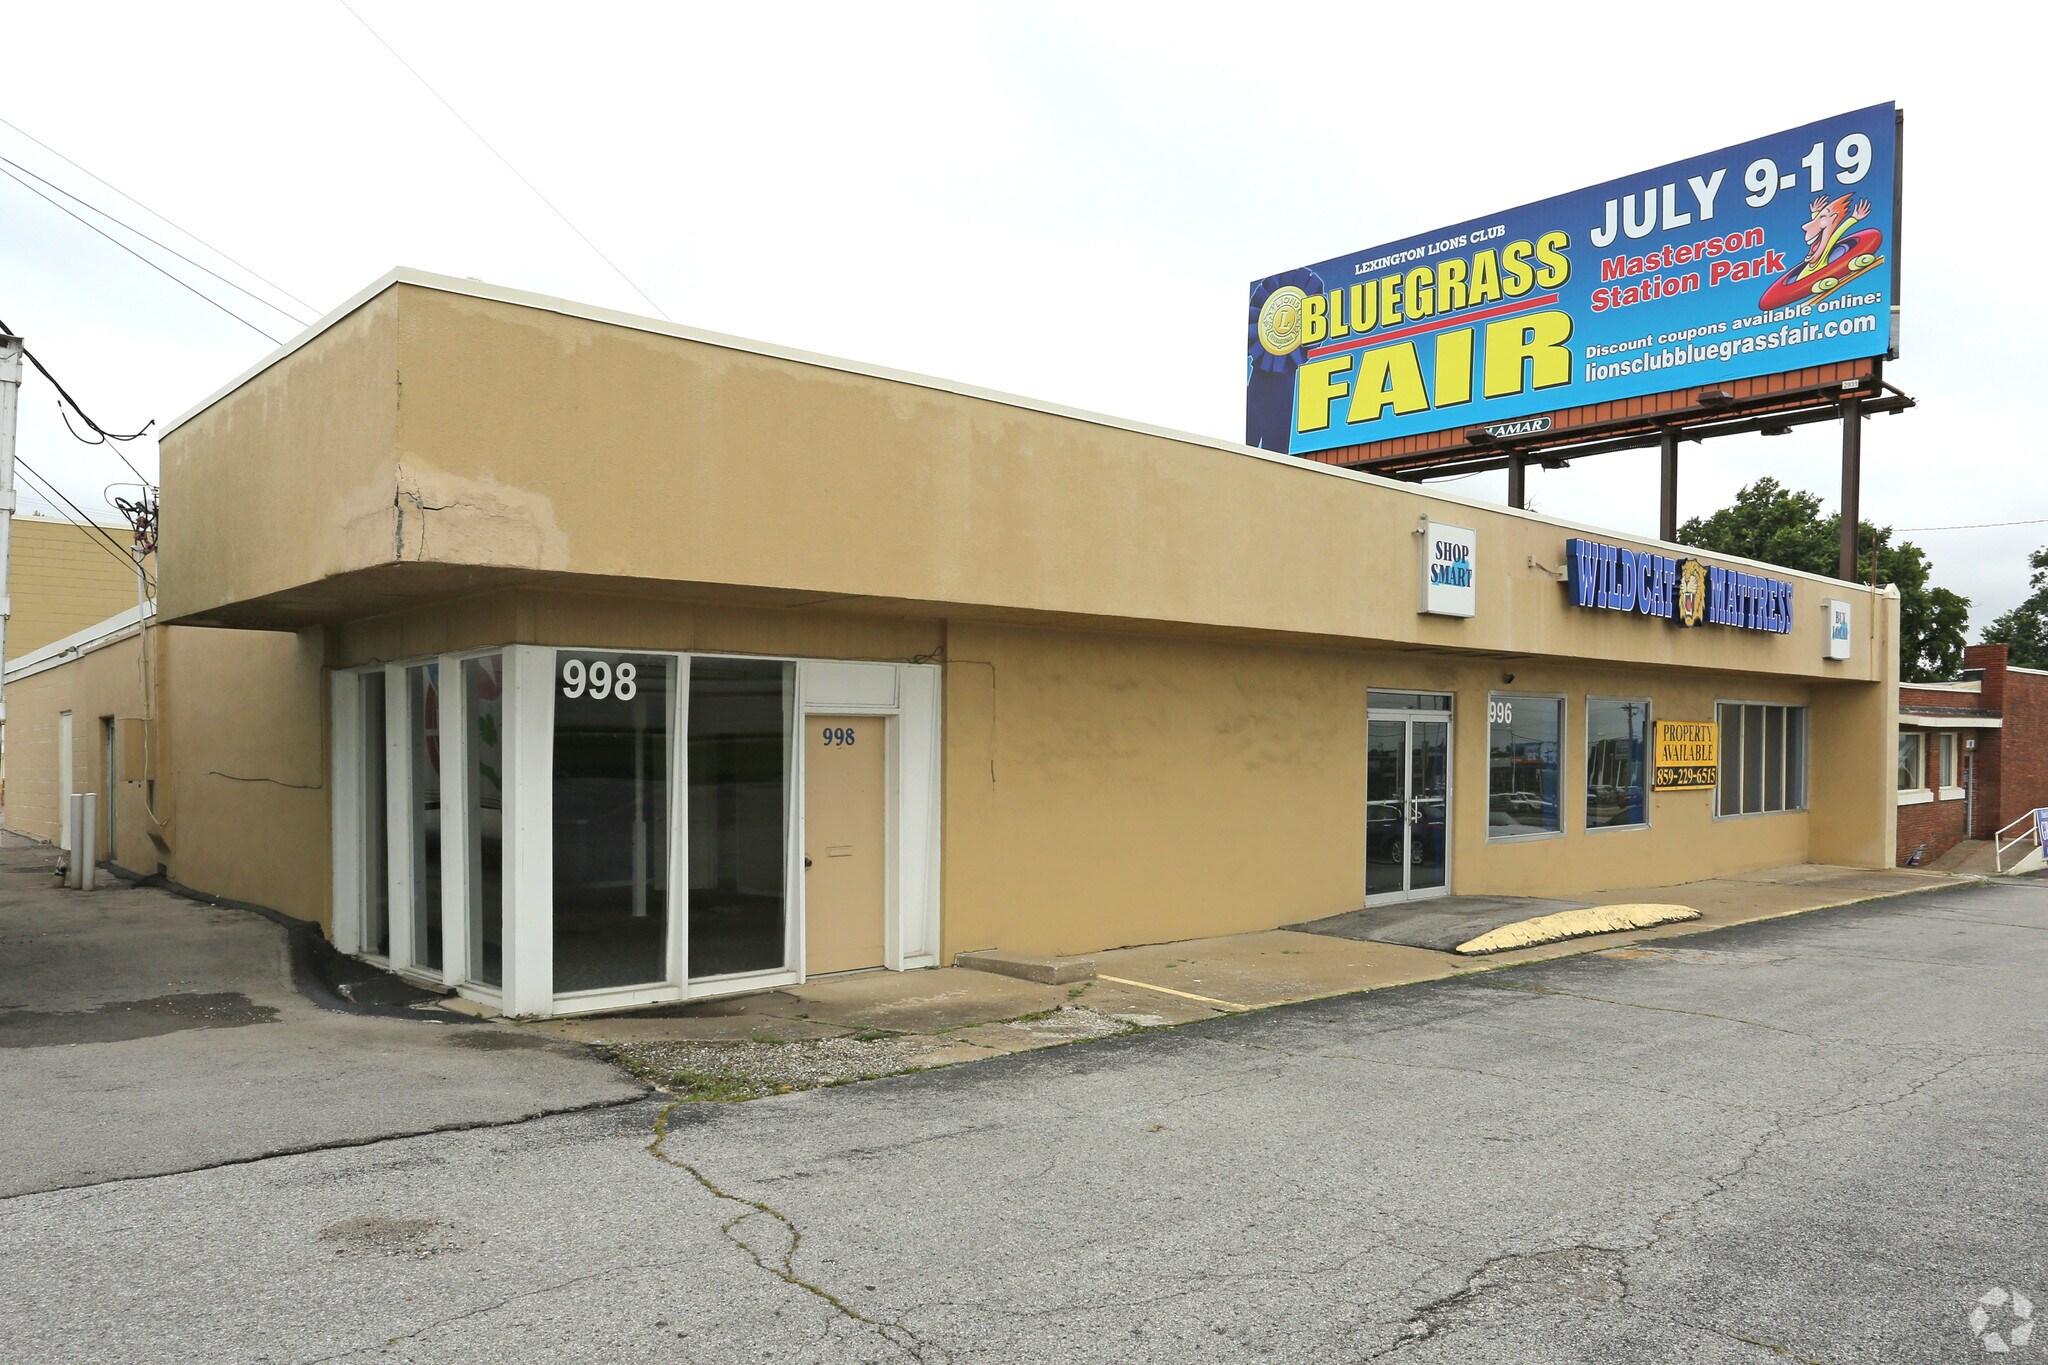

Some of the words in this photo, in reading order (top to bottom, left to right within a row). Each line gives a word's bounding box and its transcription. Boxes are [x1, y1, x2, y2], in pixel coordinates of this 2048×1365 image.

[1590, 168, 1727, 248] JULY
[1744, 132, 1872, 208] 9-19
[1355, 246, 1425, 275] LEXINGTON
[1428, 236, 1467, 256] LIONS
[1470, 225, 1505, 244] CLUB
[1600, 226, 1765, 283] Masterson
[1300, 230, 1572, 346] BLUEGRASS
[1590, 272, 1700, 313] Station
[1709, 249, 1786, 288] Park
[1585, 335, 1653, 359] Discount
[1658, 321, 1727, 346] coupons
[1732, 303, 1812, 330] available
[1818, 292, 1882, 313] online:
[1585, 314, 1876, 383] lionsclubbluegrassfair.com
[1297, 310, 1574, 433] FAIR
[1430, 563, 1472, 587] SMART
[1435, 540, 1469, 564] SHOP
[1576, 538, 1676, 618] WILDCAT
[1710, 565, 1794, 634] MATTRESS
[562, 659, 637, 701] 998
[822, 727, 855, 746] 998
[1489, 701, 1512, 724] 996
[1663, 724, 1713, 742] PROPERTY
[1657, 768, 1716, 785] 859-229-6515
[1661, 744, 1713, 761] AVAILABLE
